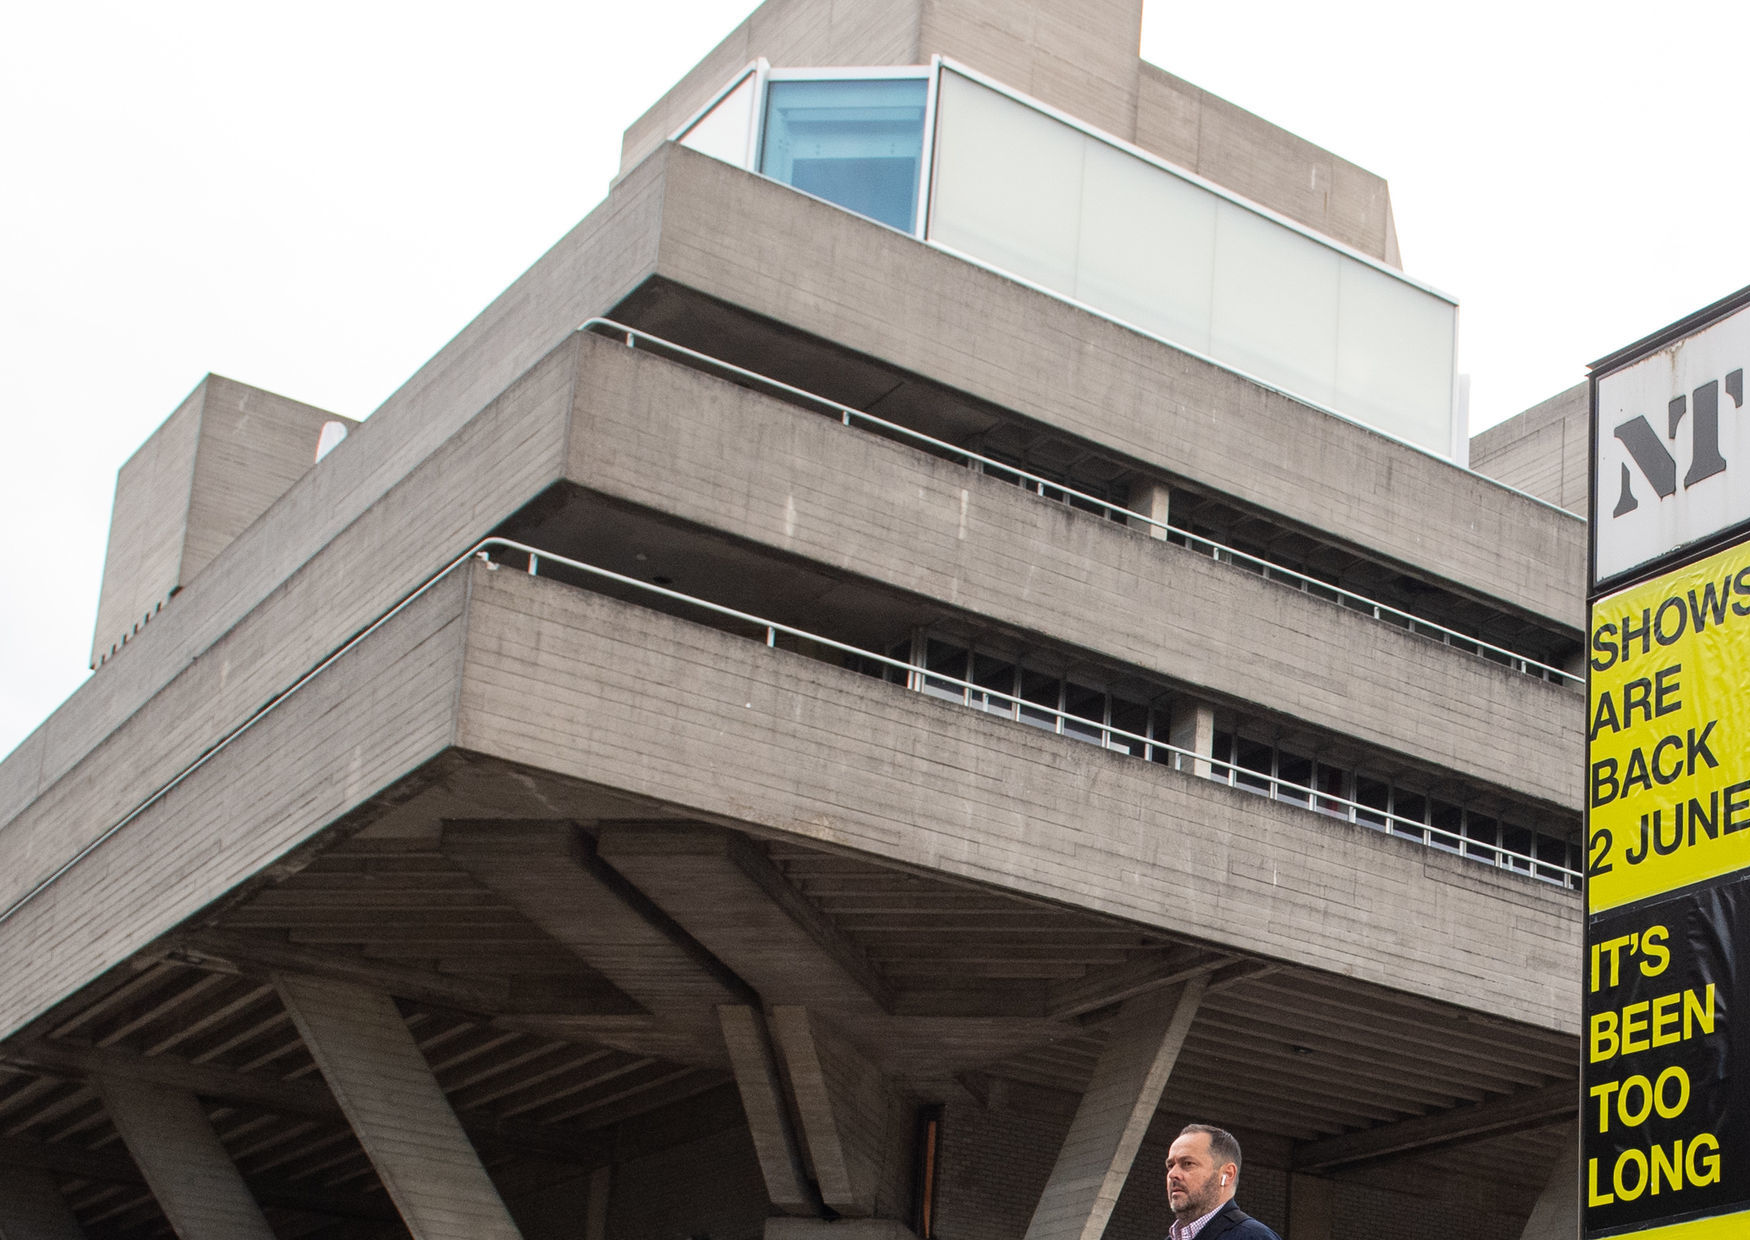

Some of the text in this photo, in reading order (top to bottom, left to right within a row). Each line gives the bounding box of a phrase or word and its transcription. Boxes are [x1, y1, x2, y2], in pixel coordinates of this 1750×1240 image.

[1613, 369, 1743, 518] NT
[1591, 664, 1682, 741] ARE
[1590, 720, 1719, 808] BACK
[1588, 830, 1613, 877] 2
[1590, 925, 1670, 993] IT’S
[1590, 983, 1716, 1064] BEEN
[1589, 1066, 1690, 1134] TOO
[1588, 1133, 1721, 1208] LONG
